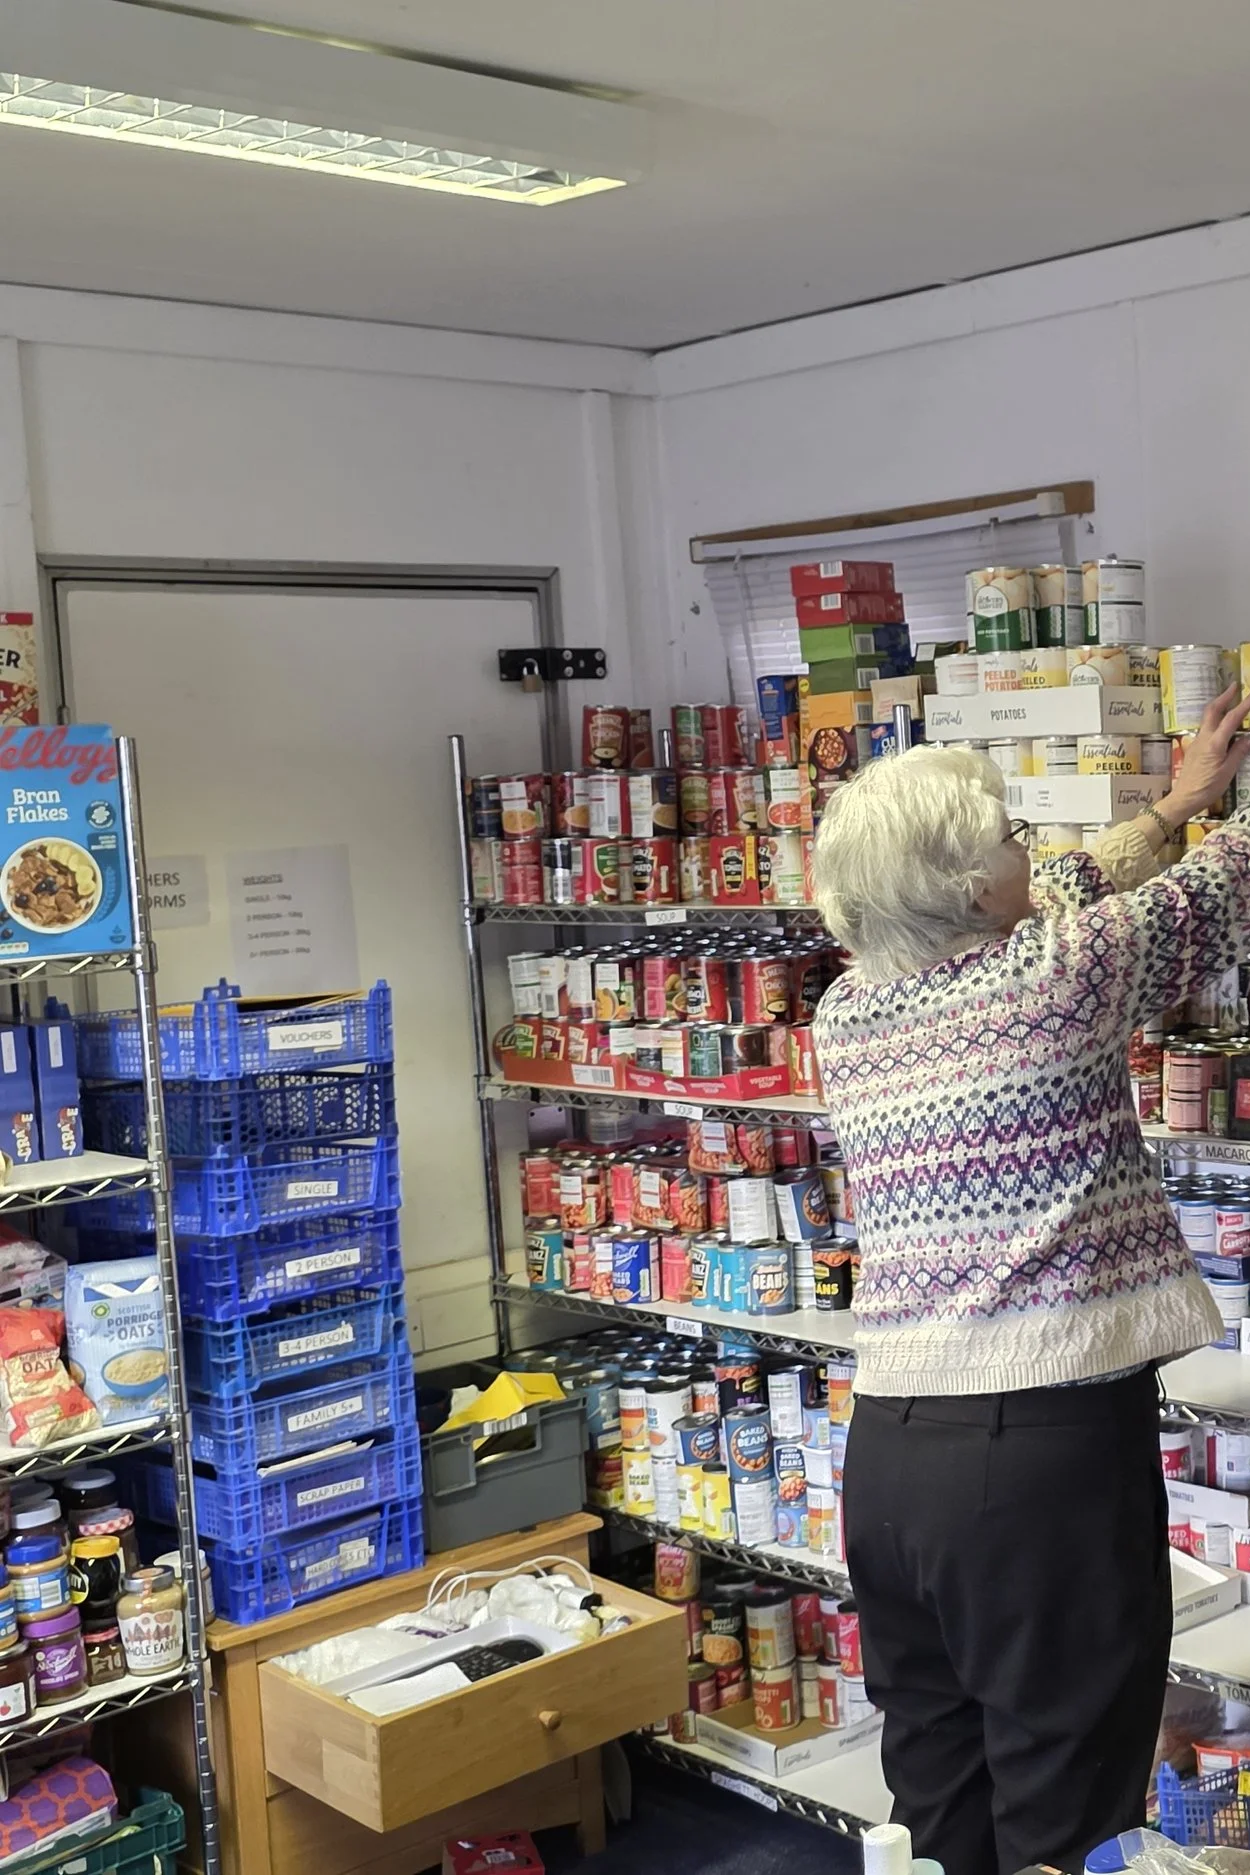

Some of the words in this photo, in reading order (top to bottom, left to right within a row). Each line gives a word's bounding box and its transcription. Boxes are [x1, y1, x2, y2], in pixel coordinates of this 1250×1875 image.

[984, 669, 1017, 680] PEELED
[984, 680, 1023, 692] POTATOE
[990, 708, 1027, 721] POTATOES
[1095, 762, 1132, 771] PEELED
[13, 788, 61, 806] Bran
[6, 804, 69, 824] Flakes
[656, 912, 677, 924] SOUP
[280, 1029, 334, 1044] VOUCHERS
[673, 1103, 694, 1117] SOUP
[293, 1183, 333, 1196] SINGLE
[295, 1261, 303, 1274] 2
[305, 1252, 352, 1271] PERSON
[752, 1271, 789, 1290] BEANS
[106, 1309, 163, 1328] PORRIDGE
[117, 1322, 156, 1341] OATS
[672, 1320, 697, 1336] BEANS
[283, 1339, 302, 1355] 3-4
[304, 1328, 351, 1348] PERSON
[294, 1406, 338, 1428] FAMILY
[339, 1401, 355, 1414] 5+
[740, 1425, 766, 1438] BAKED
[737, 1433, 769, 1448] BEANS
[779, 1459, 803, 1467] BEANS
[628, 1473, 651, 1481] BAKED
[628, 1479, 651, 1487] BEANS
[299, 1488, 330, 1503] SCRAP
[331, 1481, 361, 1495] PAPER
[1194, 1592, 1219, 1608] TOMATOES
[153, 1639, 181, 1655] EARTH
